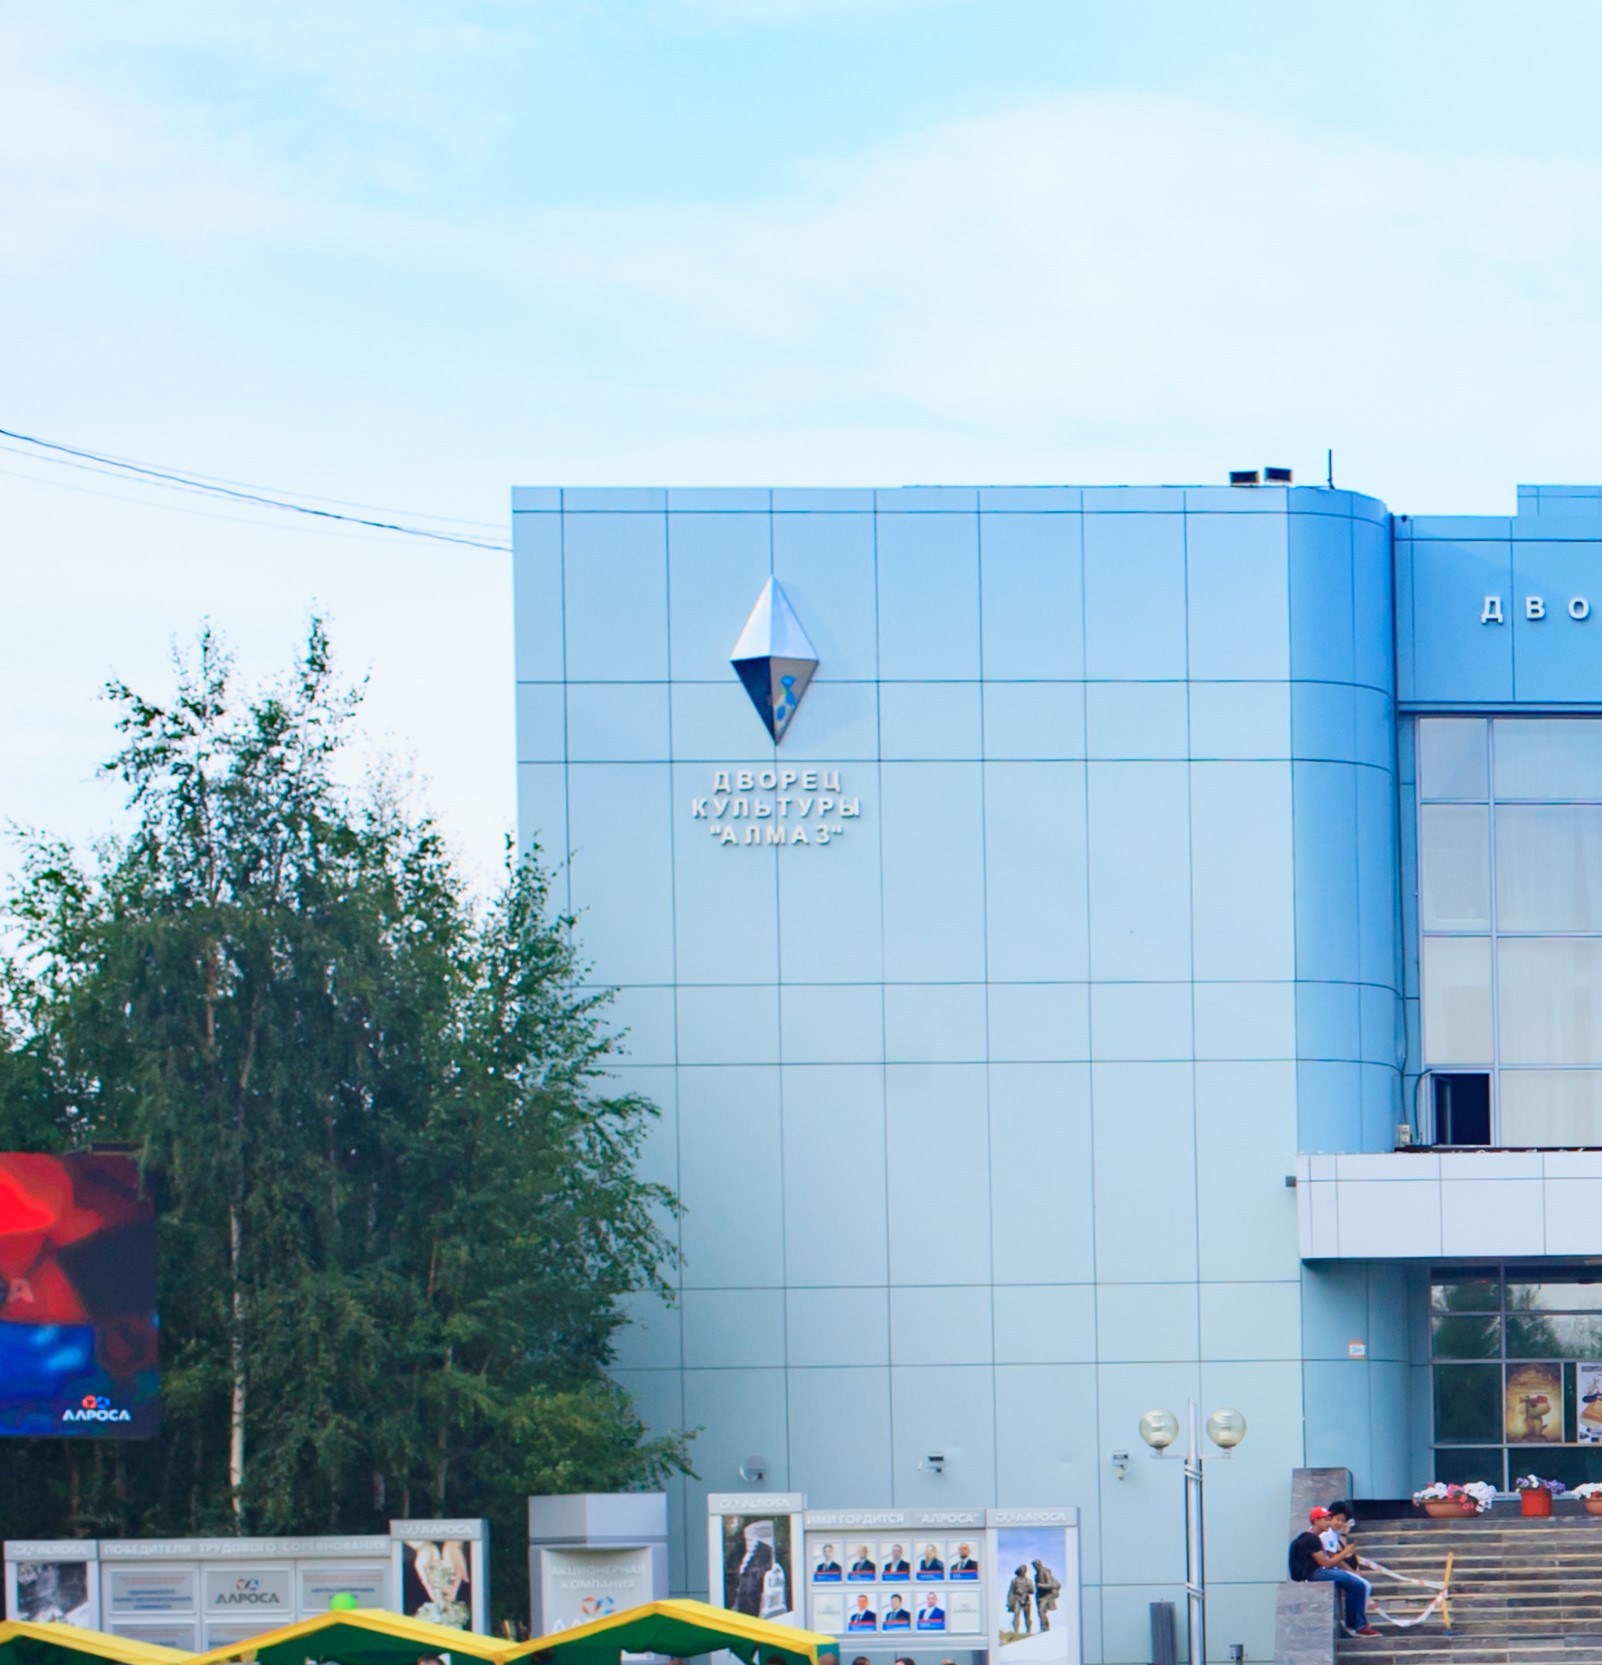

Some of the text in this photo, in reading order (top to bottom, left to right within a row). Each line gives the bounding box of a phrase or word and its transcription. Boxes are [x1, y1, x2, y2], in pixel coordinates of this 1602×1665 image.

[713, 769, 843, 796] ДВОРЕЦ
[691, 796, 861, 820] КУЛЬТУРЫ
[710, 822, 843, 846] "АЛМАЗ"
[62, 1409, 131, 1421] АЛРОСА
[806, 1512, 979, 1526] ИМИ ГОРДИТСЯ "АЛРОСА"
[104, 1540, 388, 1555] ПОБЕДИТЕЛИ ТРУДОВОГО СОРЕВНОВАНИЯ
[551, 1564, 646, 1577] АКЦИОНЕРНАЯ
[560, 1579, 636, 1590] КОМПАНИЯ
[216, 1592, 280, 1604] АЛРОСА
